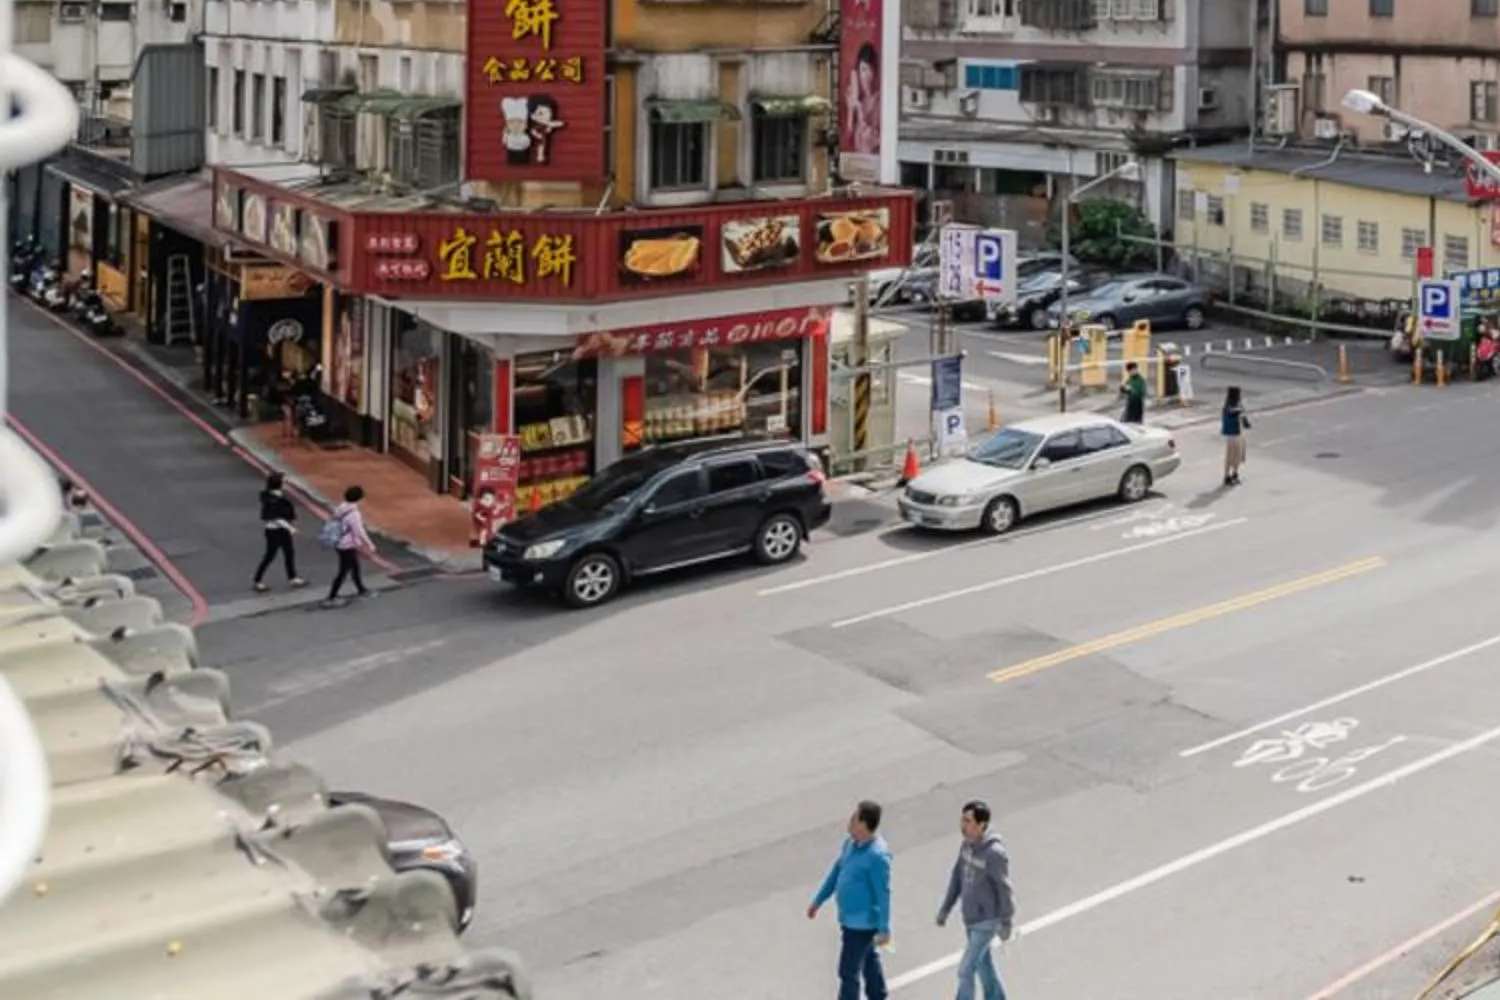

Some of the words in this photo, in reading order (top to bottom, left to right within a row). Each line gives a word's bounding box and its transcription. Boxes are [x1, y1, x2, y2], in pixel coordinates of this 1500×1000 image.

[483, 55, 585, 88] 食品公司
[440, 227, 576, 288] 宜蘭餅
[978, 238, 999, 274] P
[1424, 287, 1446, 314] P
